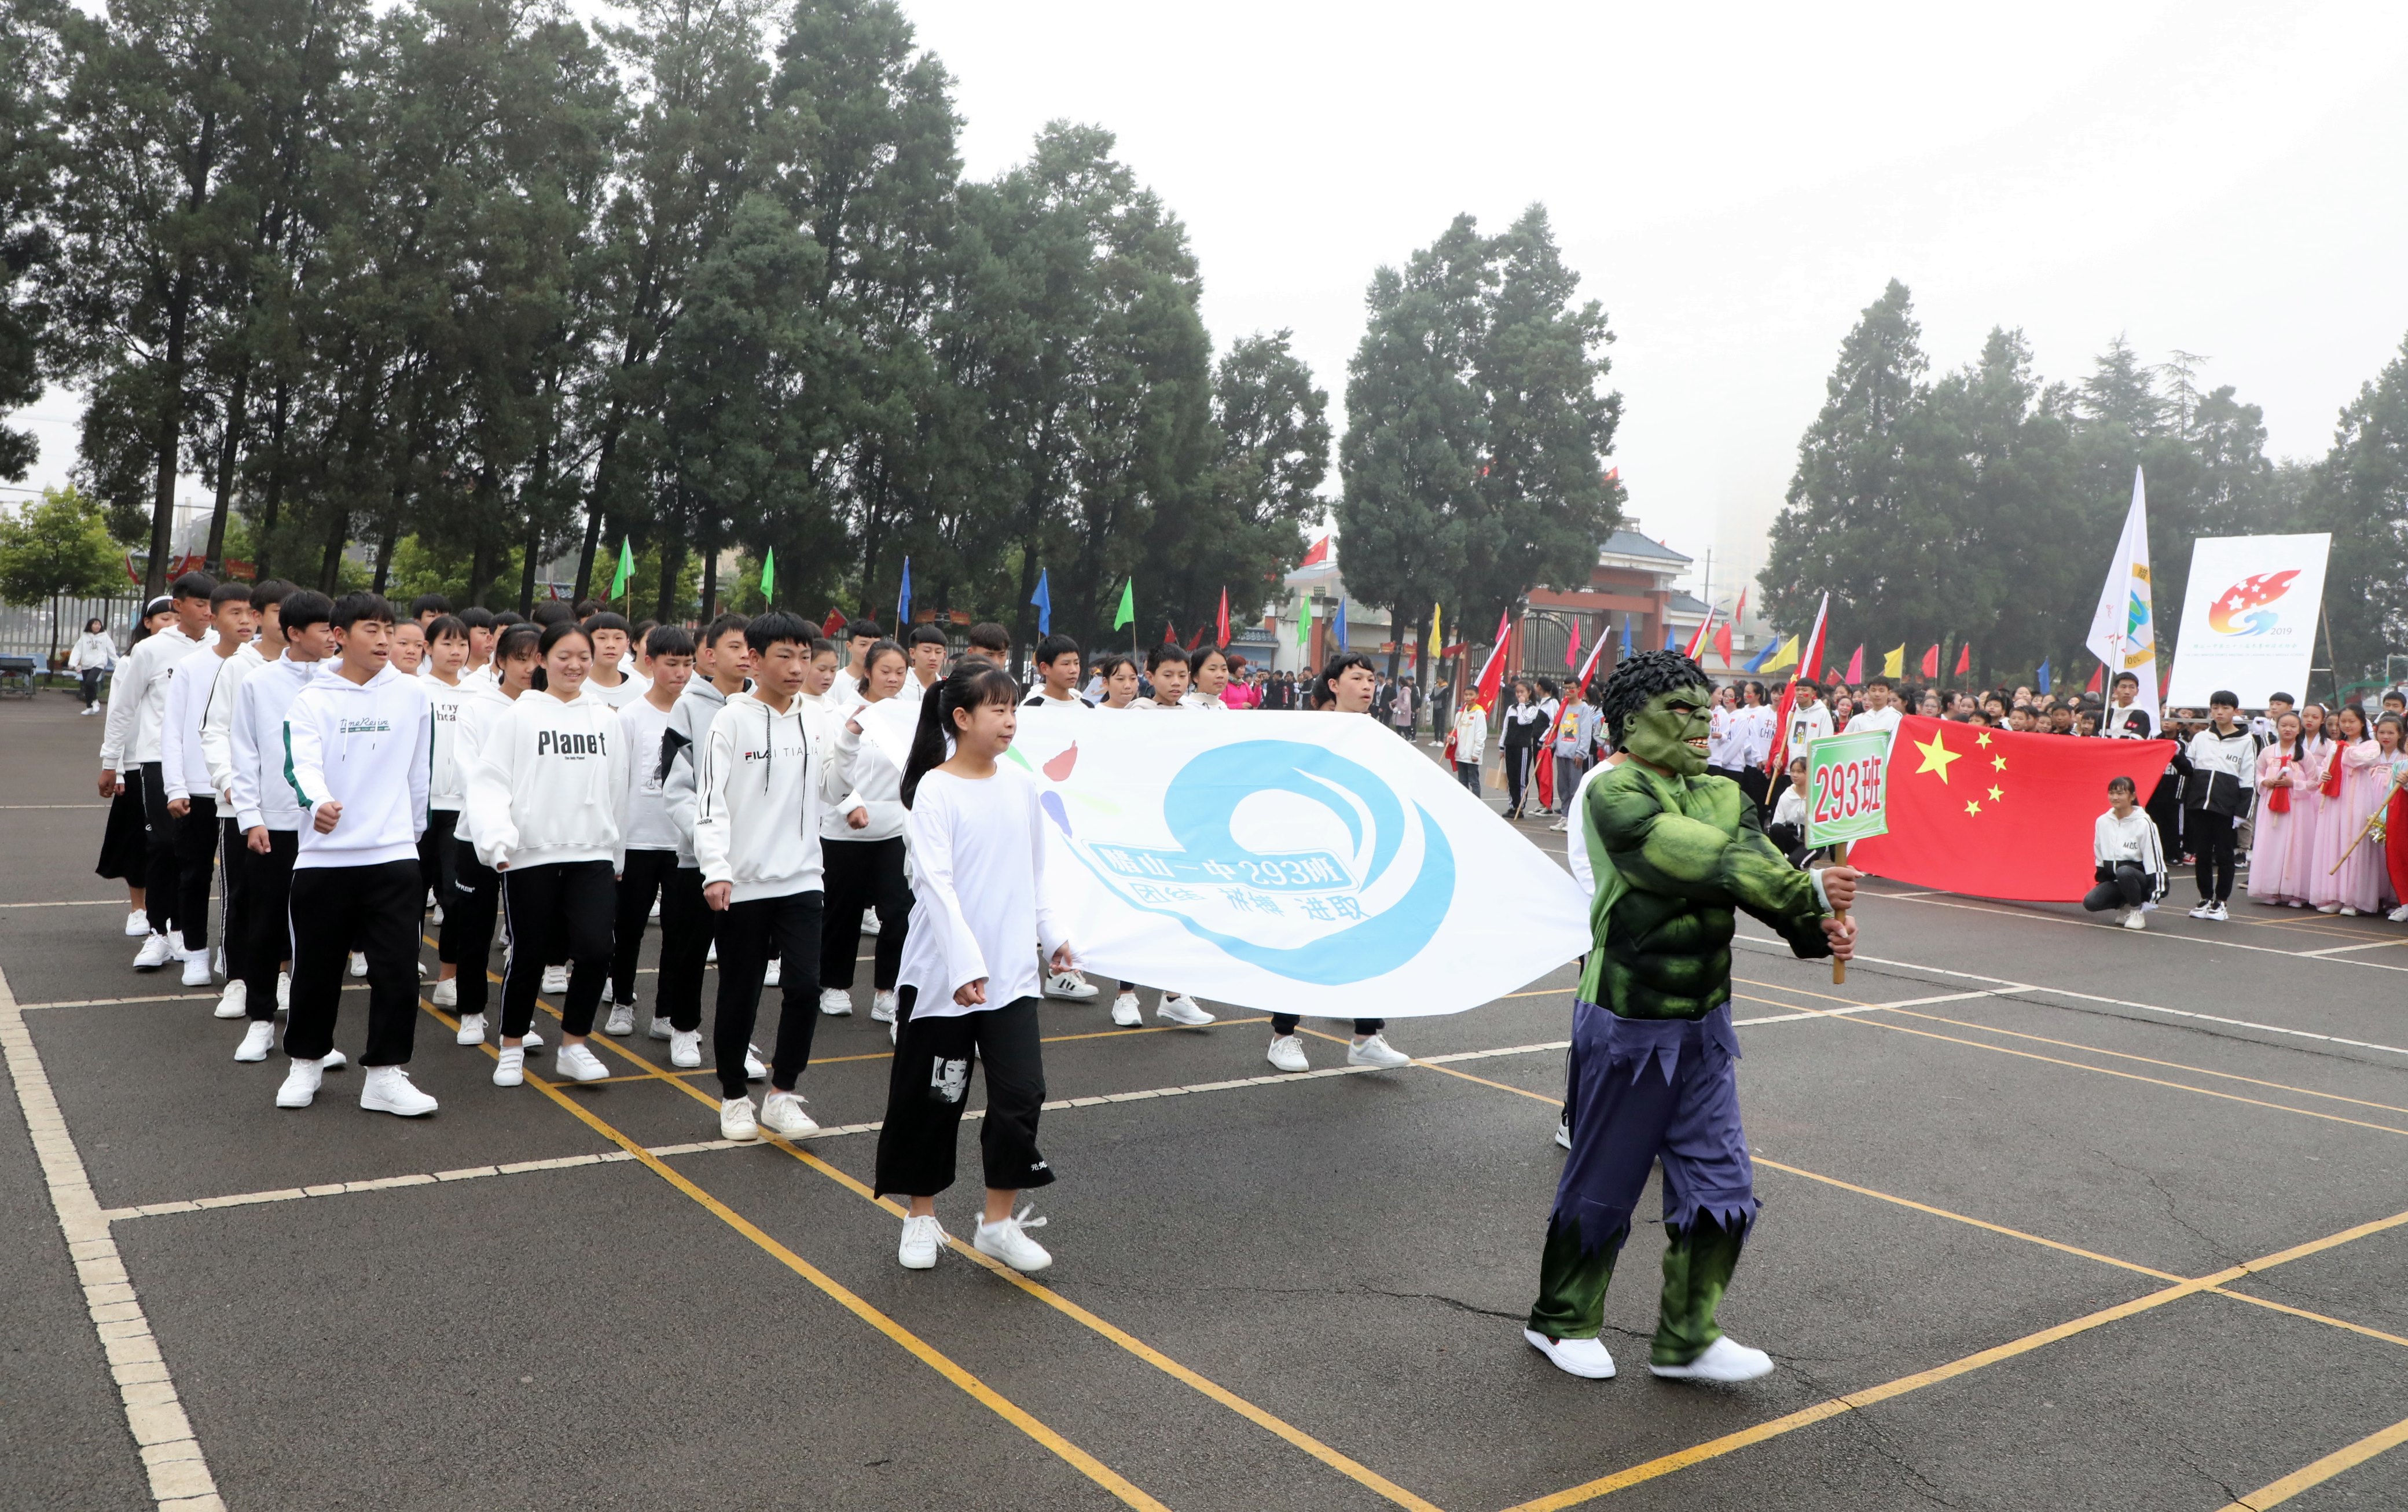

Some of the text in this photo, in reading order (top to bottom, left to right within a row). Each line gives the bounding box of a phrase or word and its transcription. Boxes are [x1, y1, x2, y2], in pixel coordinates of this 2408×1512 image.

[538, 730, 607, 756] Planet
[1760, 728, 1775, 740] CHIN
[1814, 755, 1881, 823] 293班
[1129, 882, 1207, 903] 团结
[1294, 896, 1371, 921] 进取
